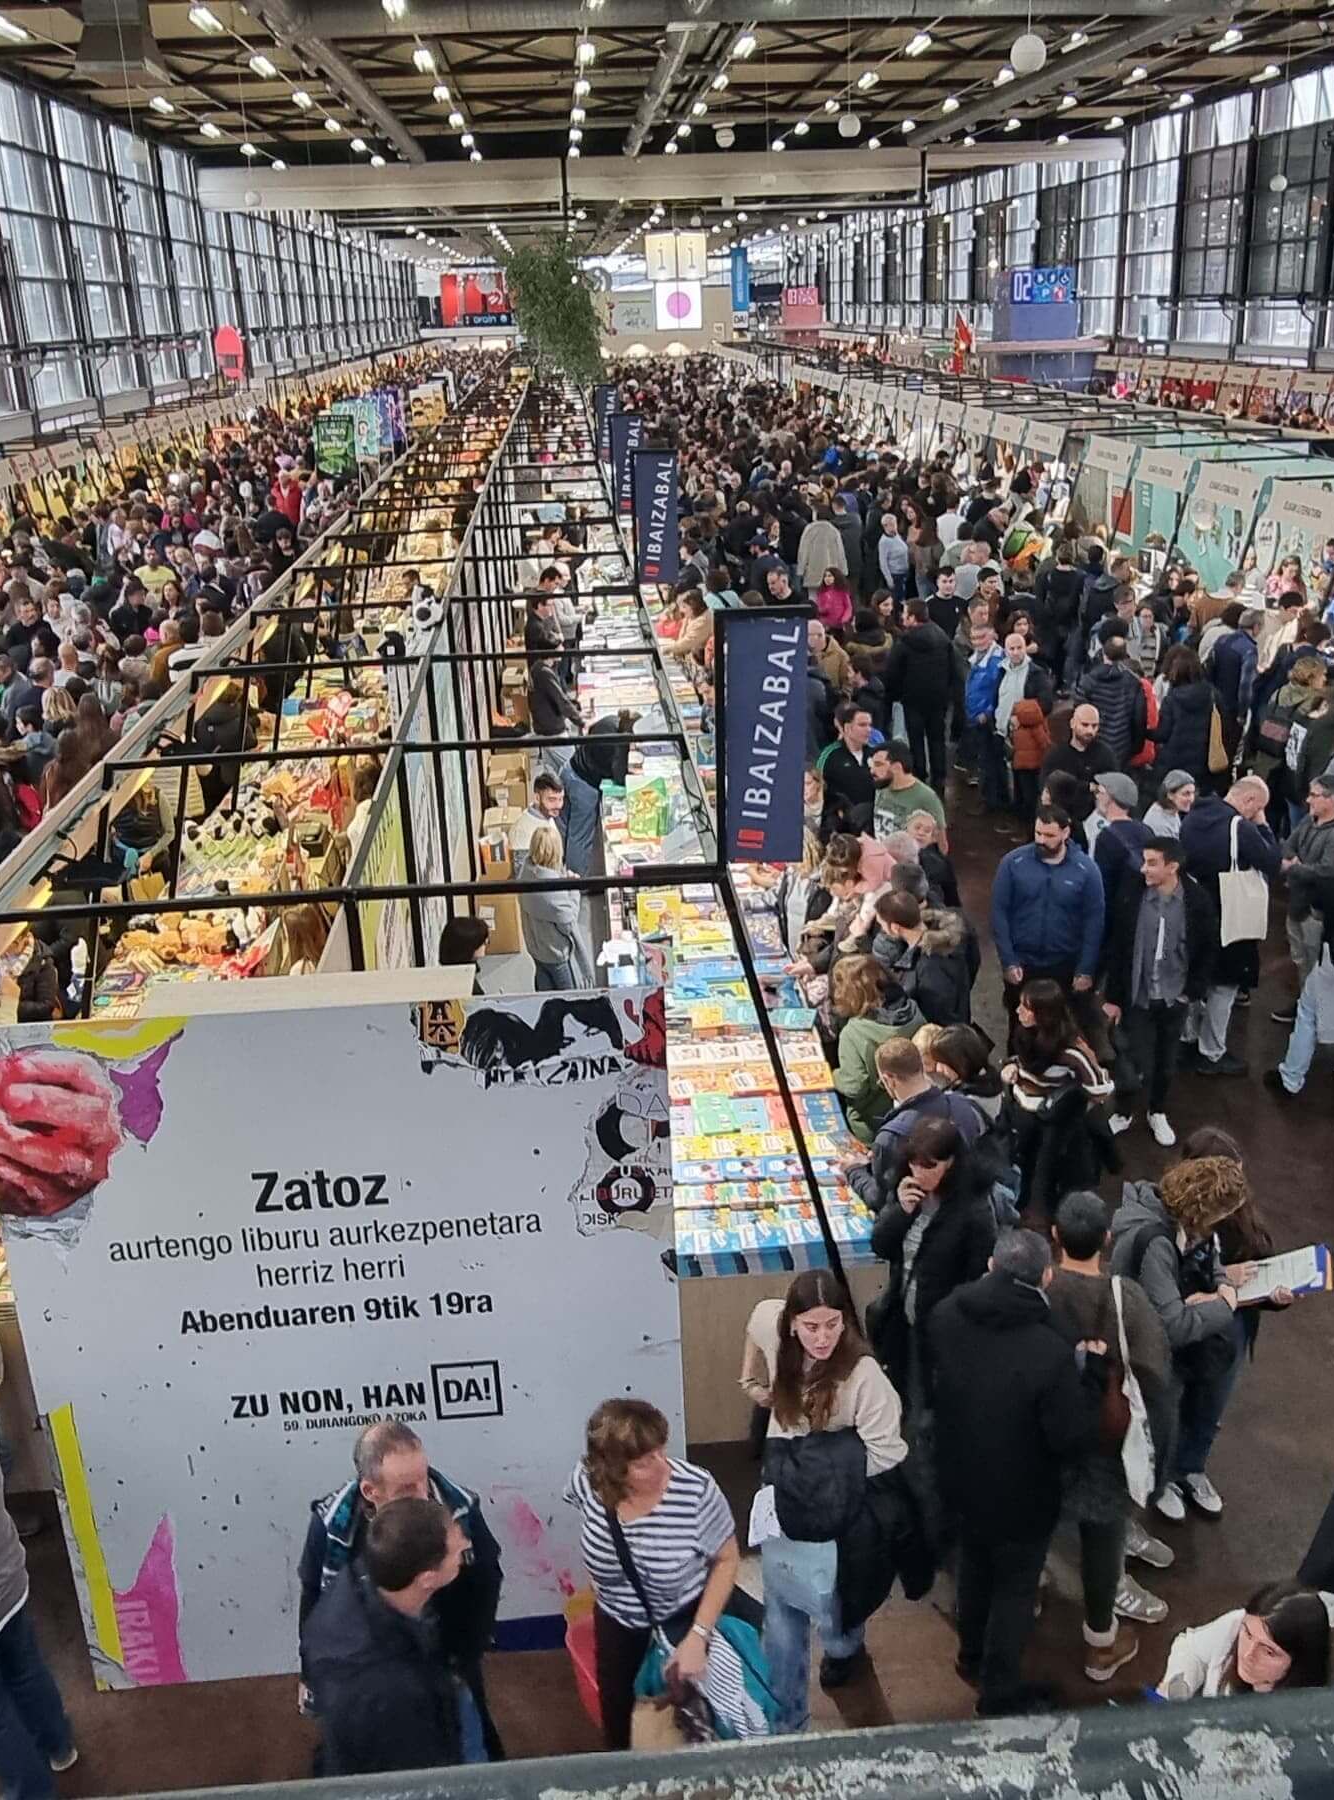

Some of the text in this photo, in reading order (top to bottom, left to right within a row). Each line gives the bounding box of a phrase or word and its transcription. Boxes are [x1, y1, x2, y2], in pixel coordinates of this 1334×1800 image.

[1013, 272, 1032, 301] 02
[646, 457, 674, 561] IBAIZABAL
[741, 625, 801, 819] IBAIZABAL
[251, 1169, 389, 1214] Zatoz
[109, 1211, 543, 1262] aurtengo liburu aurkezpenetara
[256, 1254, 406, 1288] herriz herri
[180, 1291, 494, 1335] Abenduaren 9tik 19ra
[231, 1377, 493, 1419] ZU NON, HAN DA!
